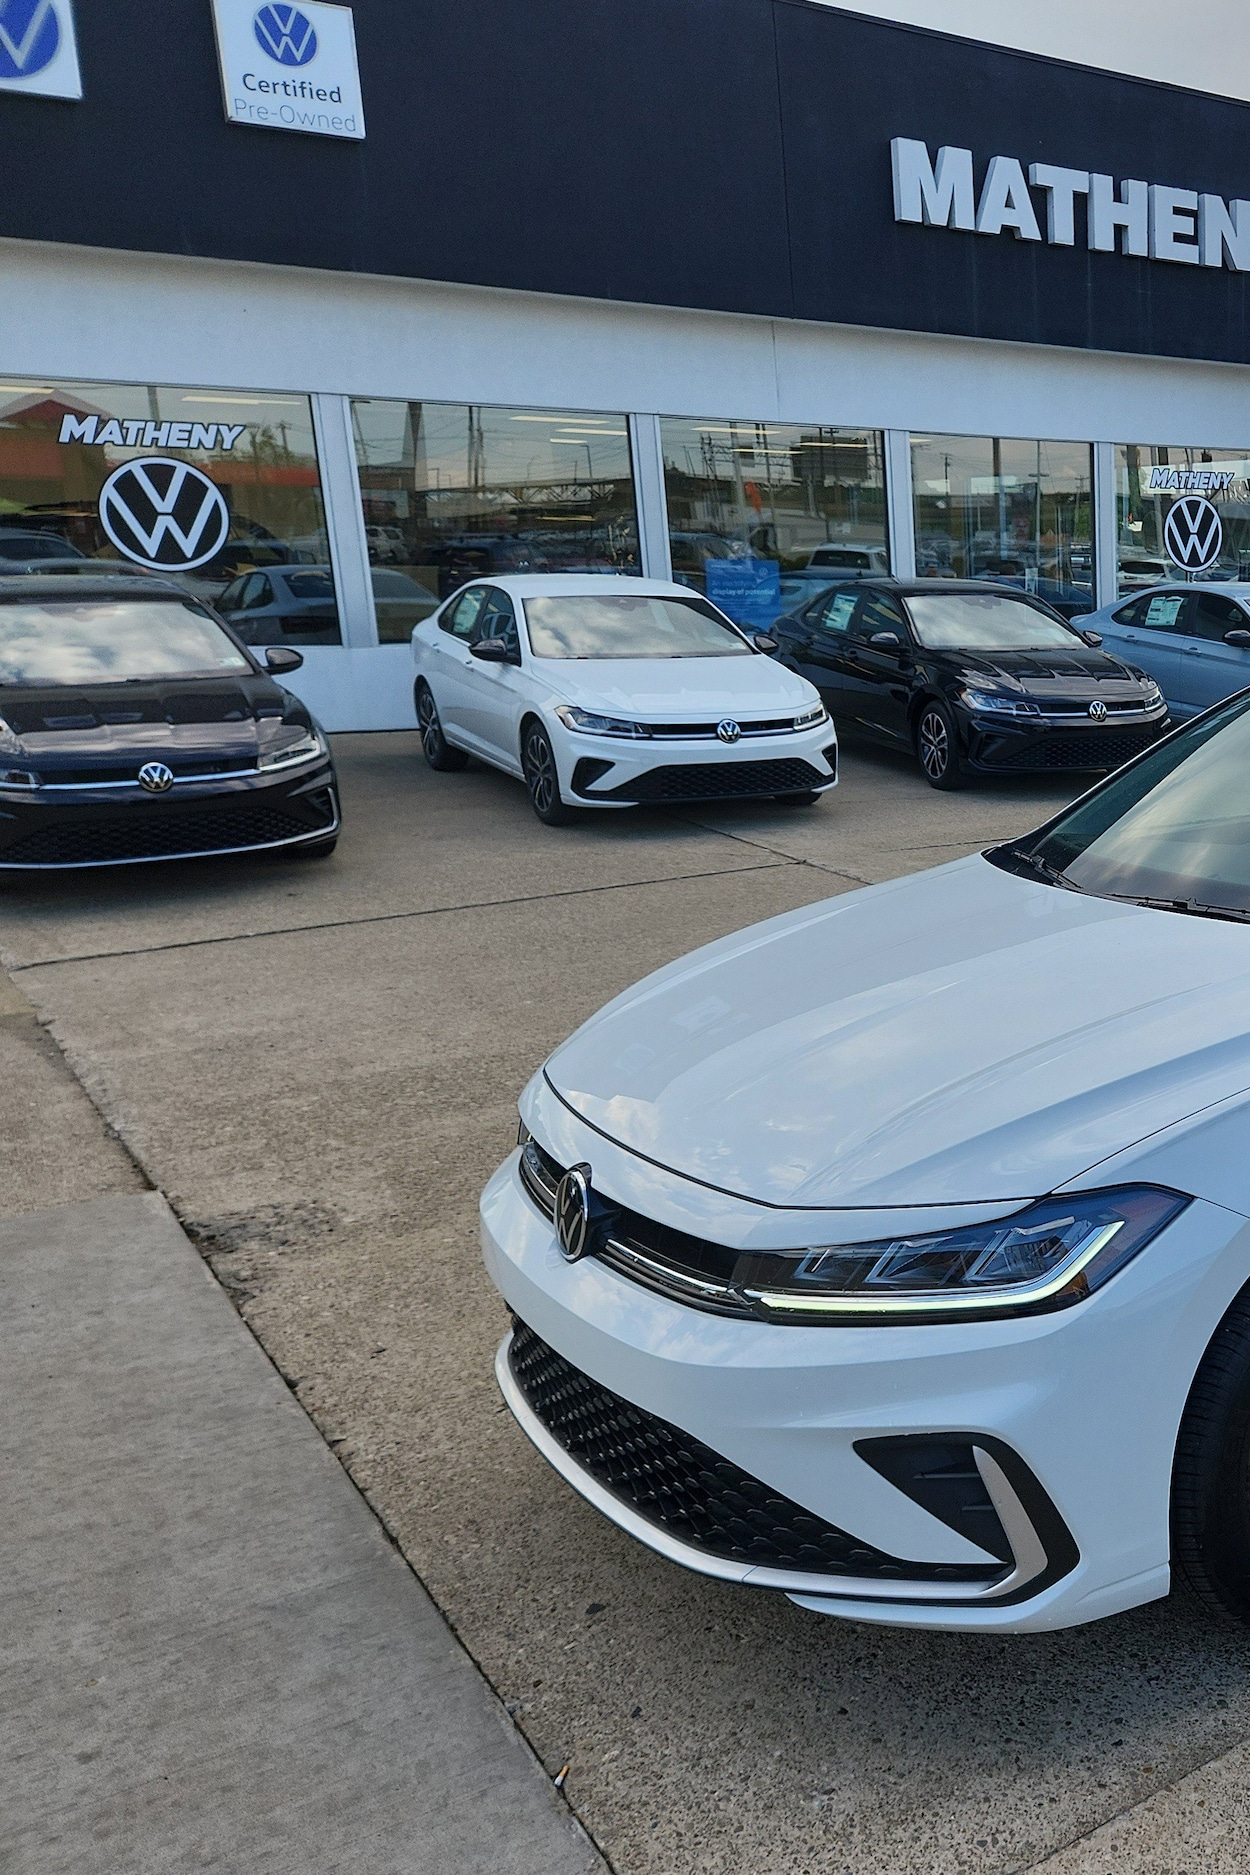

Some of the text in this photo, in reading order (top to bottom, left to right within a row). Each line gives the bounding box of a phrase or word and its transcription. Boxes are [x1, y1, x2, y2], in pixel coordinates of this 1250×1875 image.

[242, 73, 342, 103] Certified
[233, 97, 357, 132] Pre-Owned
[58, 413, 246, 451] MATHENY
[1149, 467, 1236, 490] MATHENY
